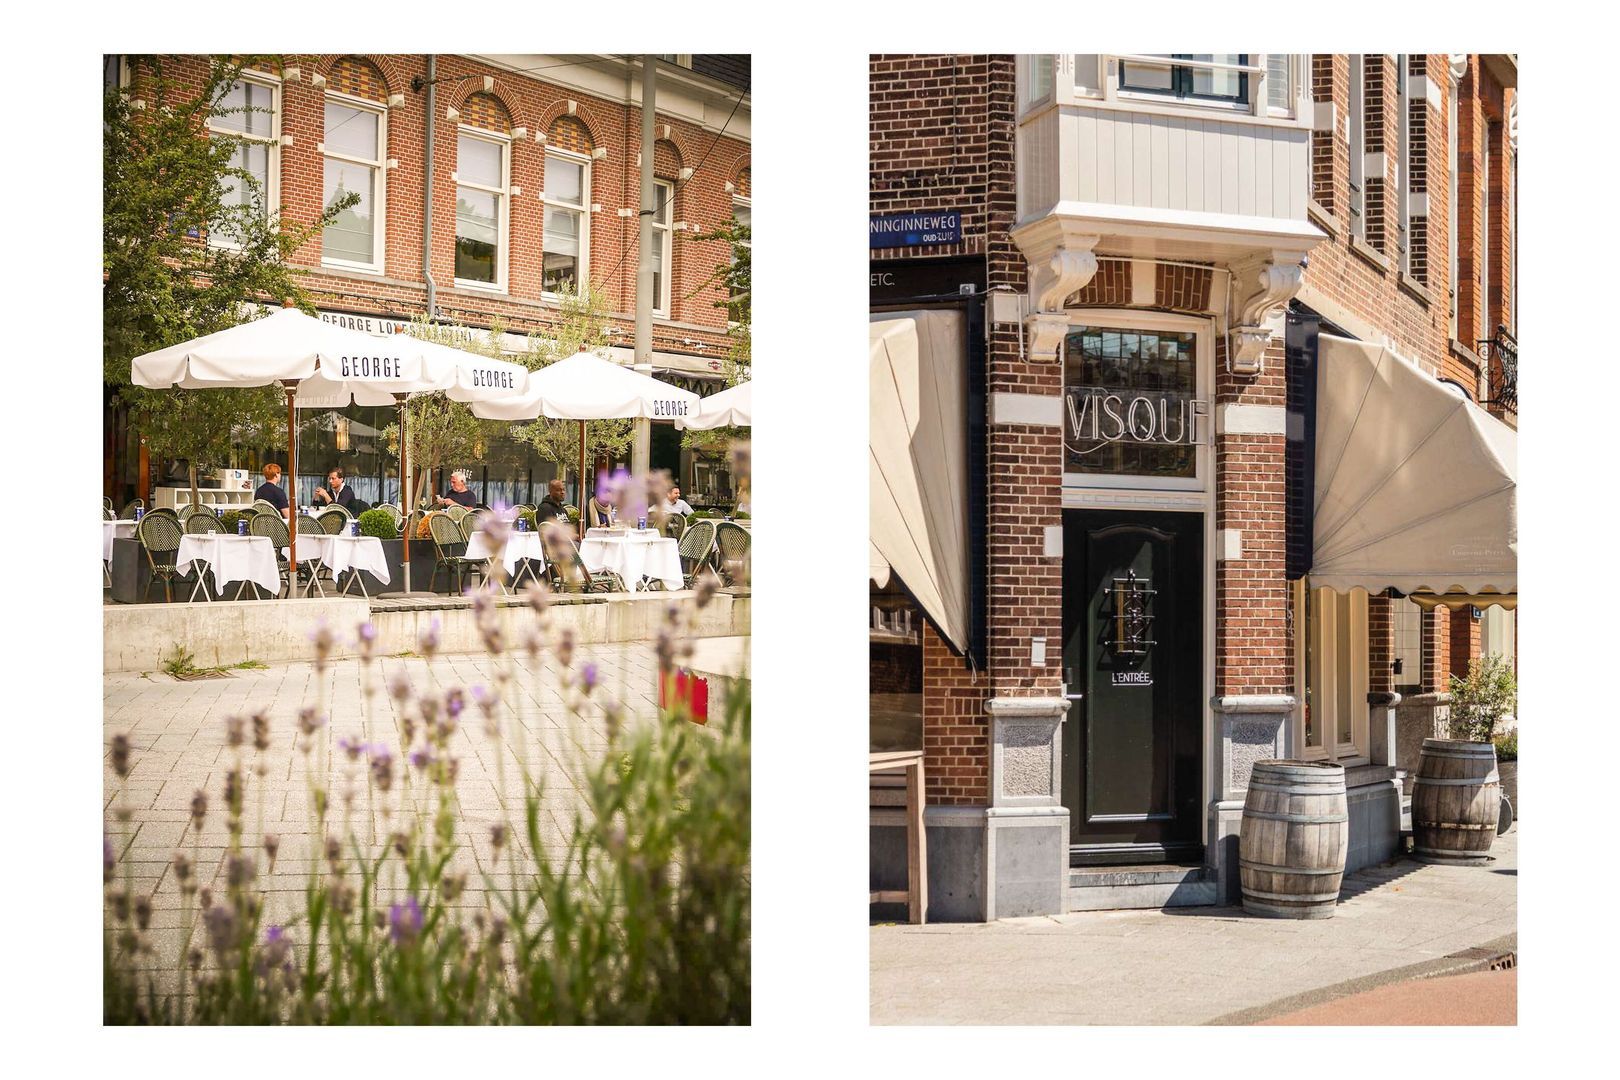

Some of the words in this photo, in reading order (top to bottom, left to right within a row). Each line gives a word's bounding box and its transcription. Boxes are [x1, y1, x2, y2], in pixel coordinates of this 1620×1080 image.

[870, 273, 895, 287] ETC.
[322, 314, 372, 332] GEORGE
[341, 356, 401, 378] GEORGE
[472, 369, 514, 389] GEORGE
[653, 400, 688, 416] GEORGE
